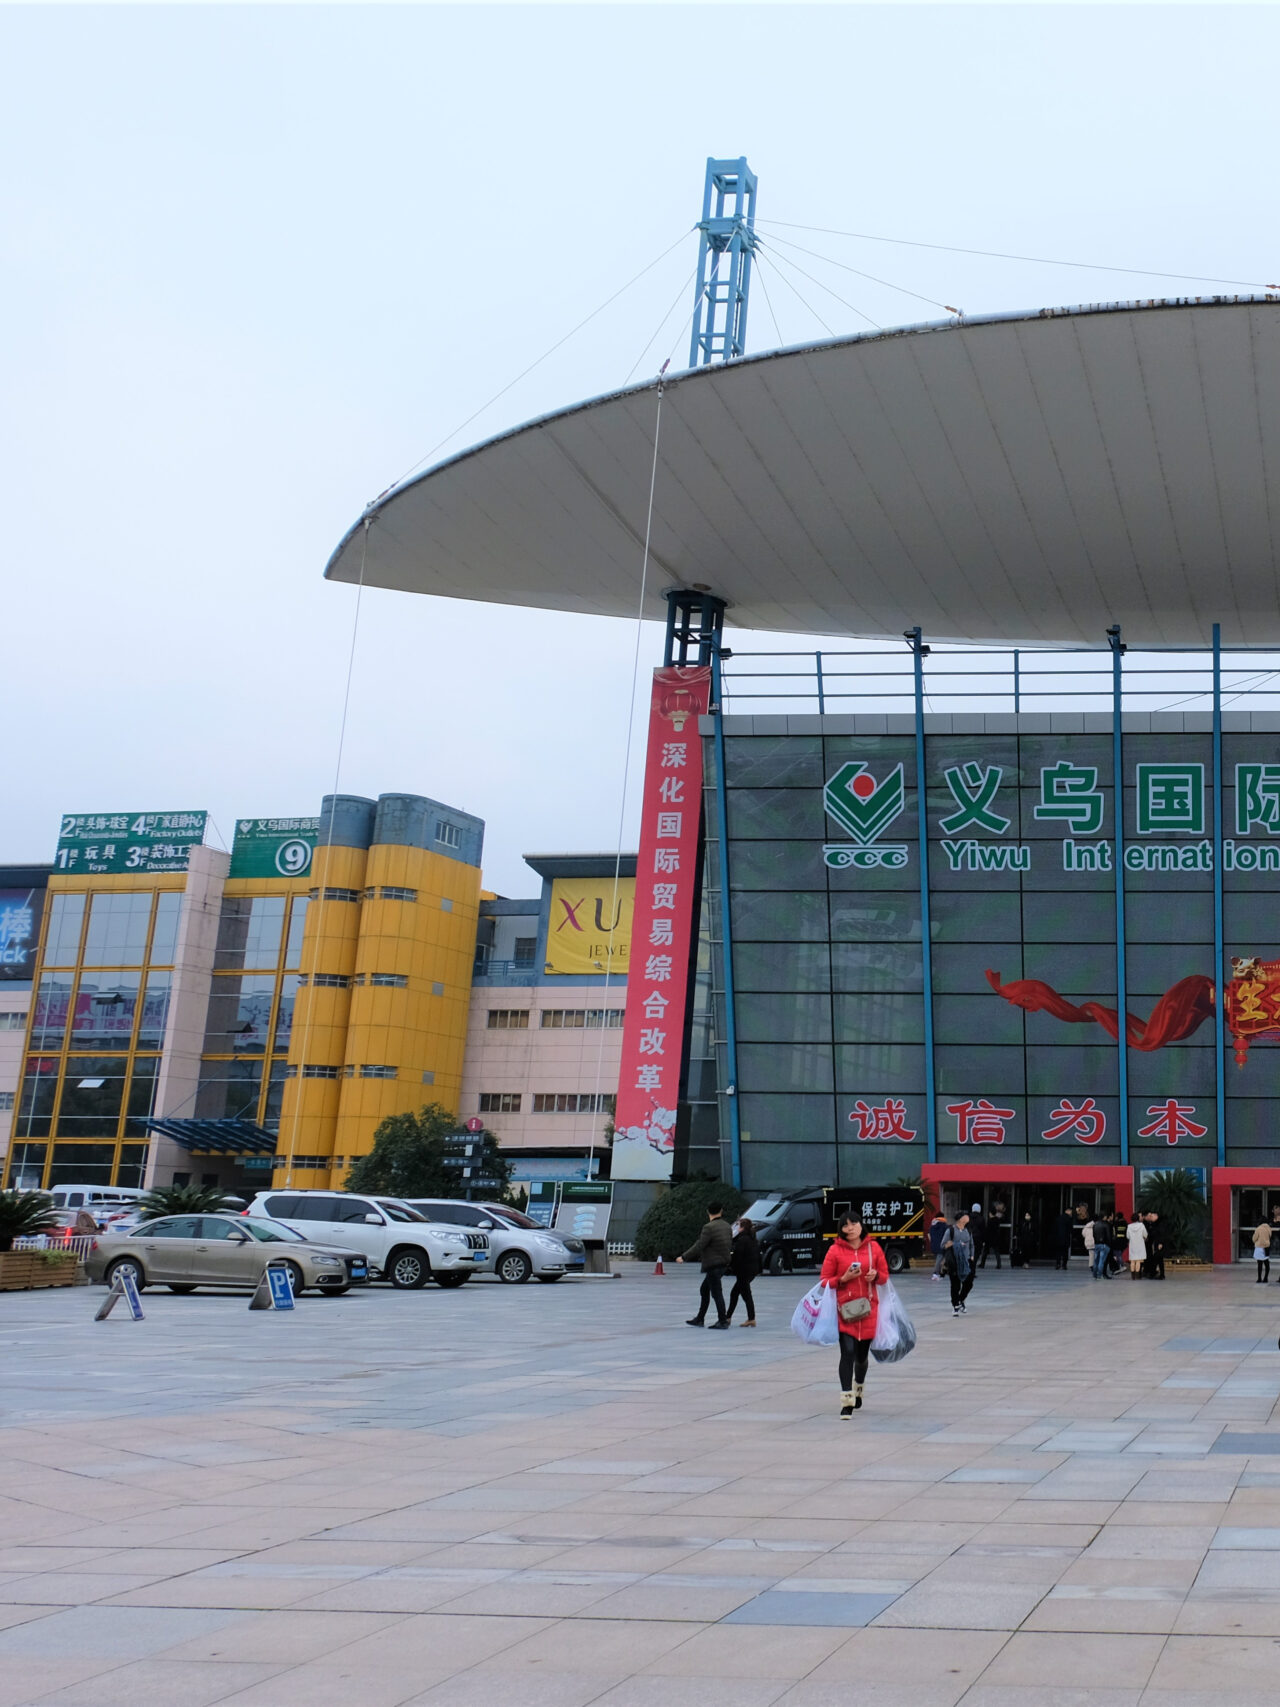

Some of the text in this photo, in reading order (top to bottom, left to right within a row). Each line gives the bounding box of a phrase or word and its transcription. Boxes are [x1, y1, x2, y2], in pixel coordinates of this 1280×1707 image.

[60, 817, 77, 838] 2
[131, 815, 146, 836] 4
[58, 848, 68, 869] 1
[84, 844, 116, 860] 玩具
[125, 846, 141, 867] 3
[88, 863, 107, 872] Toys
[941, 840, 1030, 871] Yiwu
[0, 906, 32, 942] 棒
[634, 742, 687, 1093] 深化国际贸易综合改革
[849, 1098, 1208, 1145] 诚信为本
[862, 1201, 914, 1217] 保安护卫
